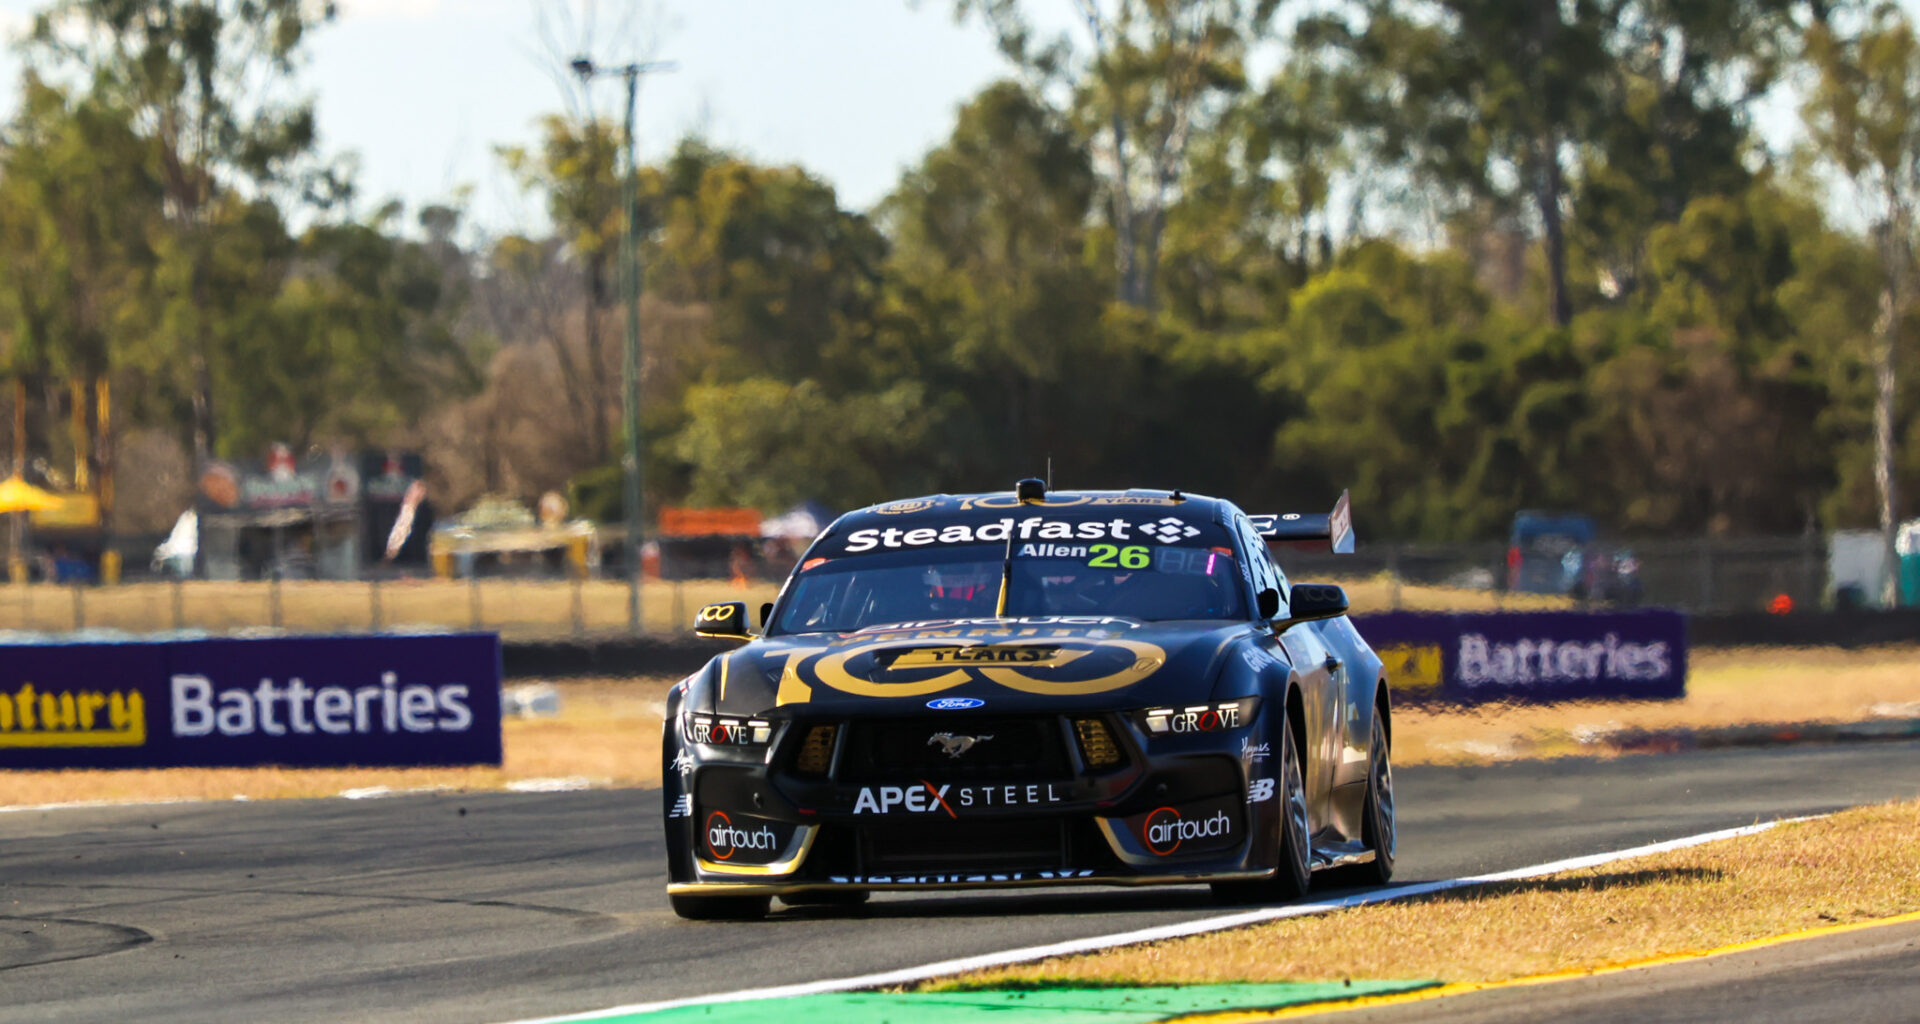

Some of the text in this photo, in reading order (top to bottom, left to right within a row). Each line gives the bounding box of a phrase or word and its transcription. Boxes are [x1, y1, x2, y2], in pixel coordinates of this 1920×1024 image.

[845, 517, 1132, 552] Steadfast
[1021, 544, 1150, 569] Allen 26
[1458, 633, 1671, 686] Batteries
[171, 672, 473, 738] Batteries
[1171, 710, 1240, 733] GROVE
[693, 724, 748, 744] GROVE
[853, 781, 1060, 818] APEX STEEL
[708, 825, 776, 851] airtouch
[1148, 810, 1230, 845] airtouch
